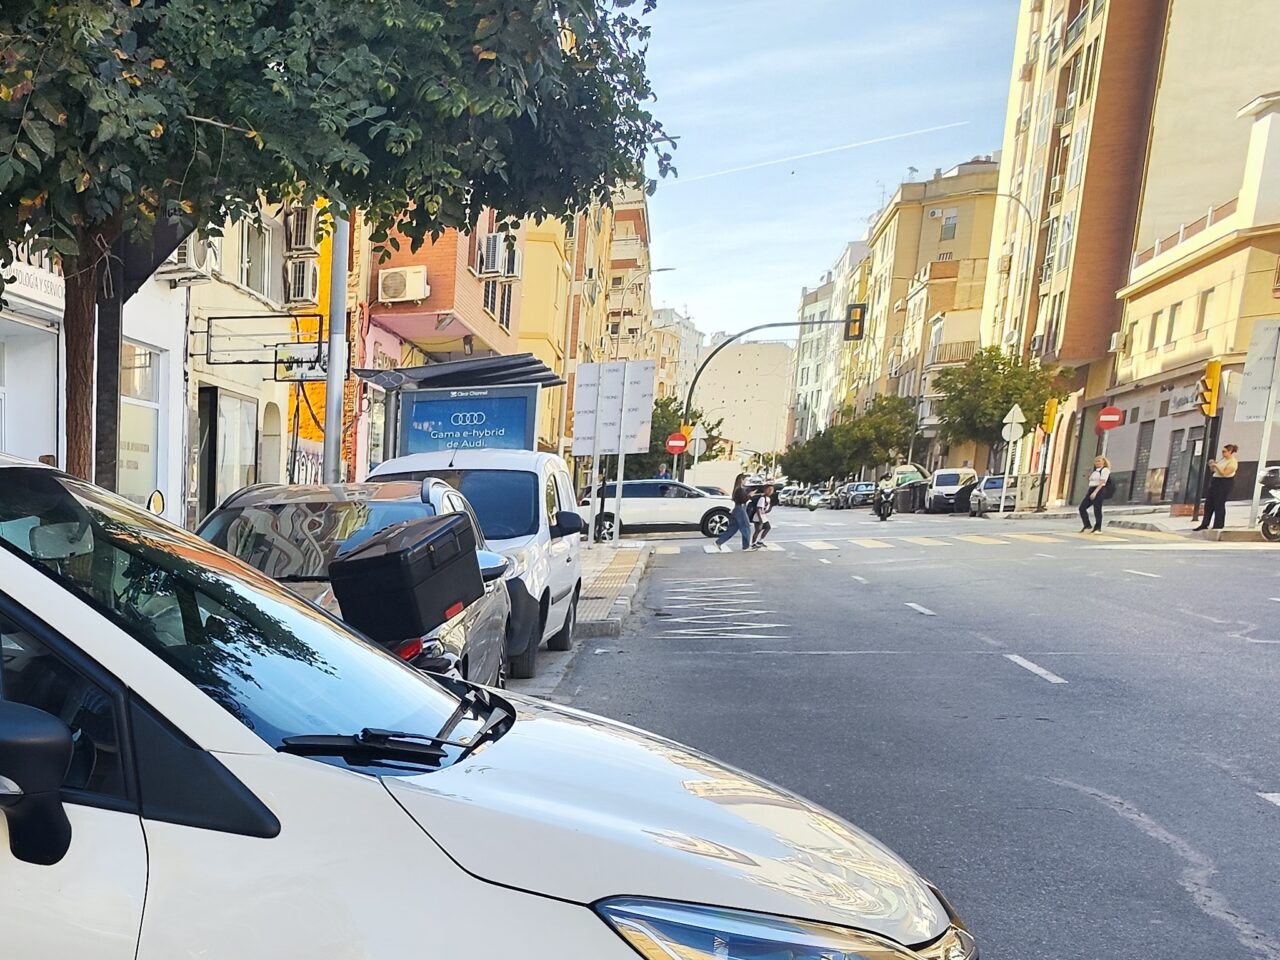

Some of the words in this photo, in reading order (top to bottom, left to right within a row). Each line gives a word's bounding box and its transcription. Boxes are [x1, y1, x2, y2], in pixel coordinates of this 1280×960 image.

[431, 430, 460, 439] Gama
[463, 428, 505, 438] e-hybrid
[446, 440, 459, 449] de
[461, 439, 487, 448] Audi.
